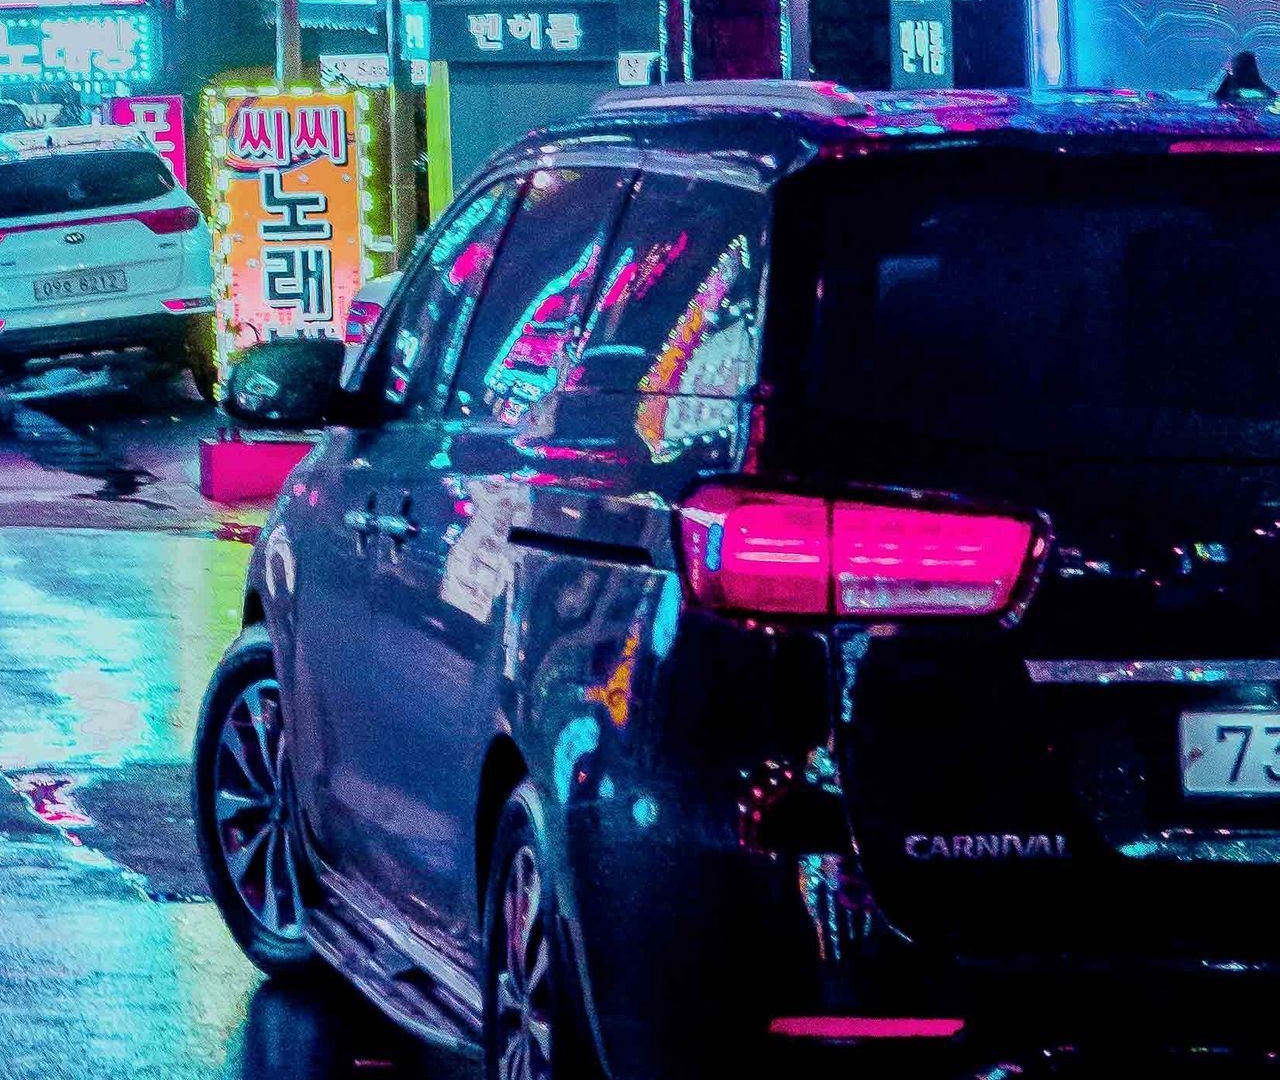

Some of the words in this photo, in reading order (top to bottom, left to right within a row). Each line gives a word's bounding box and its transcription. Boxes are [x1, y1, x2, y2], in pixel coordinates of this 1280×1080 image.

[467, 12, 583, 52] 벤허룸
[260, 169, 334, 340] 노래
[904, 833, 1071, 860] CARNIVAL
